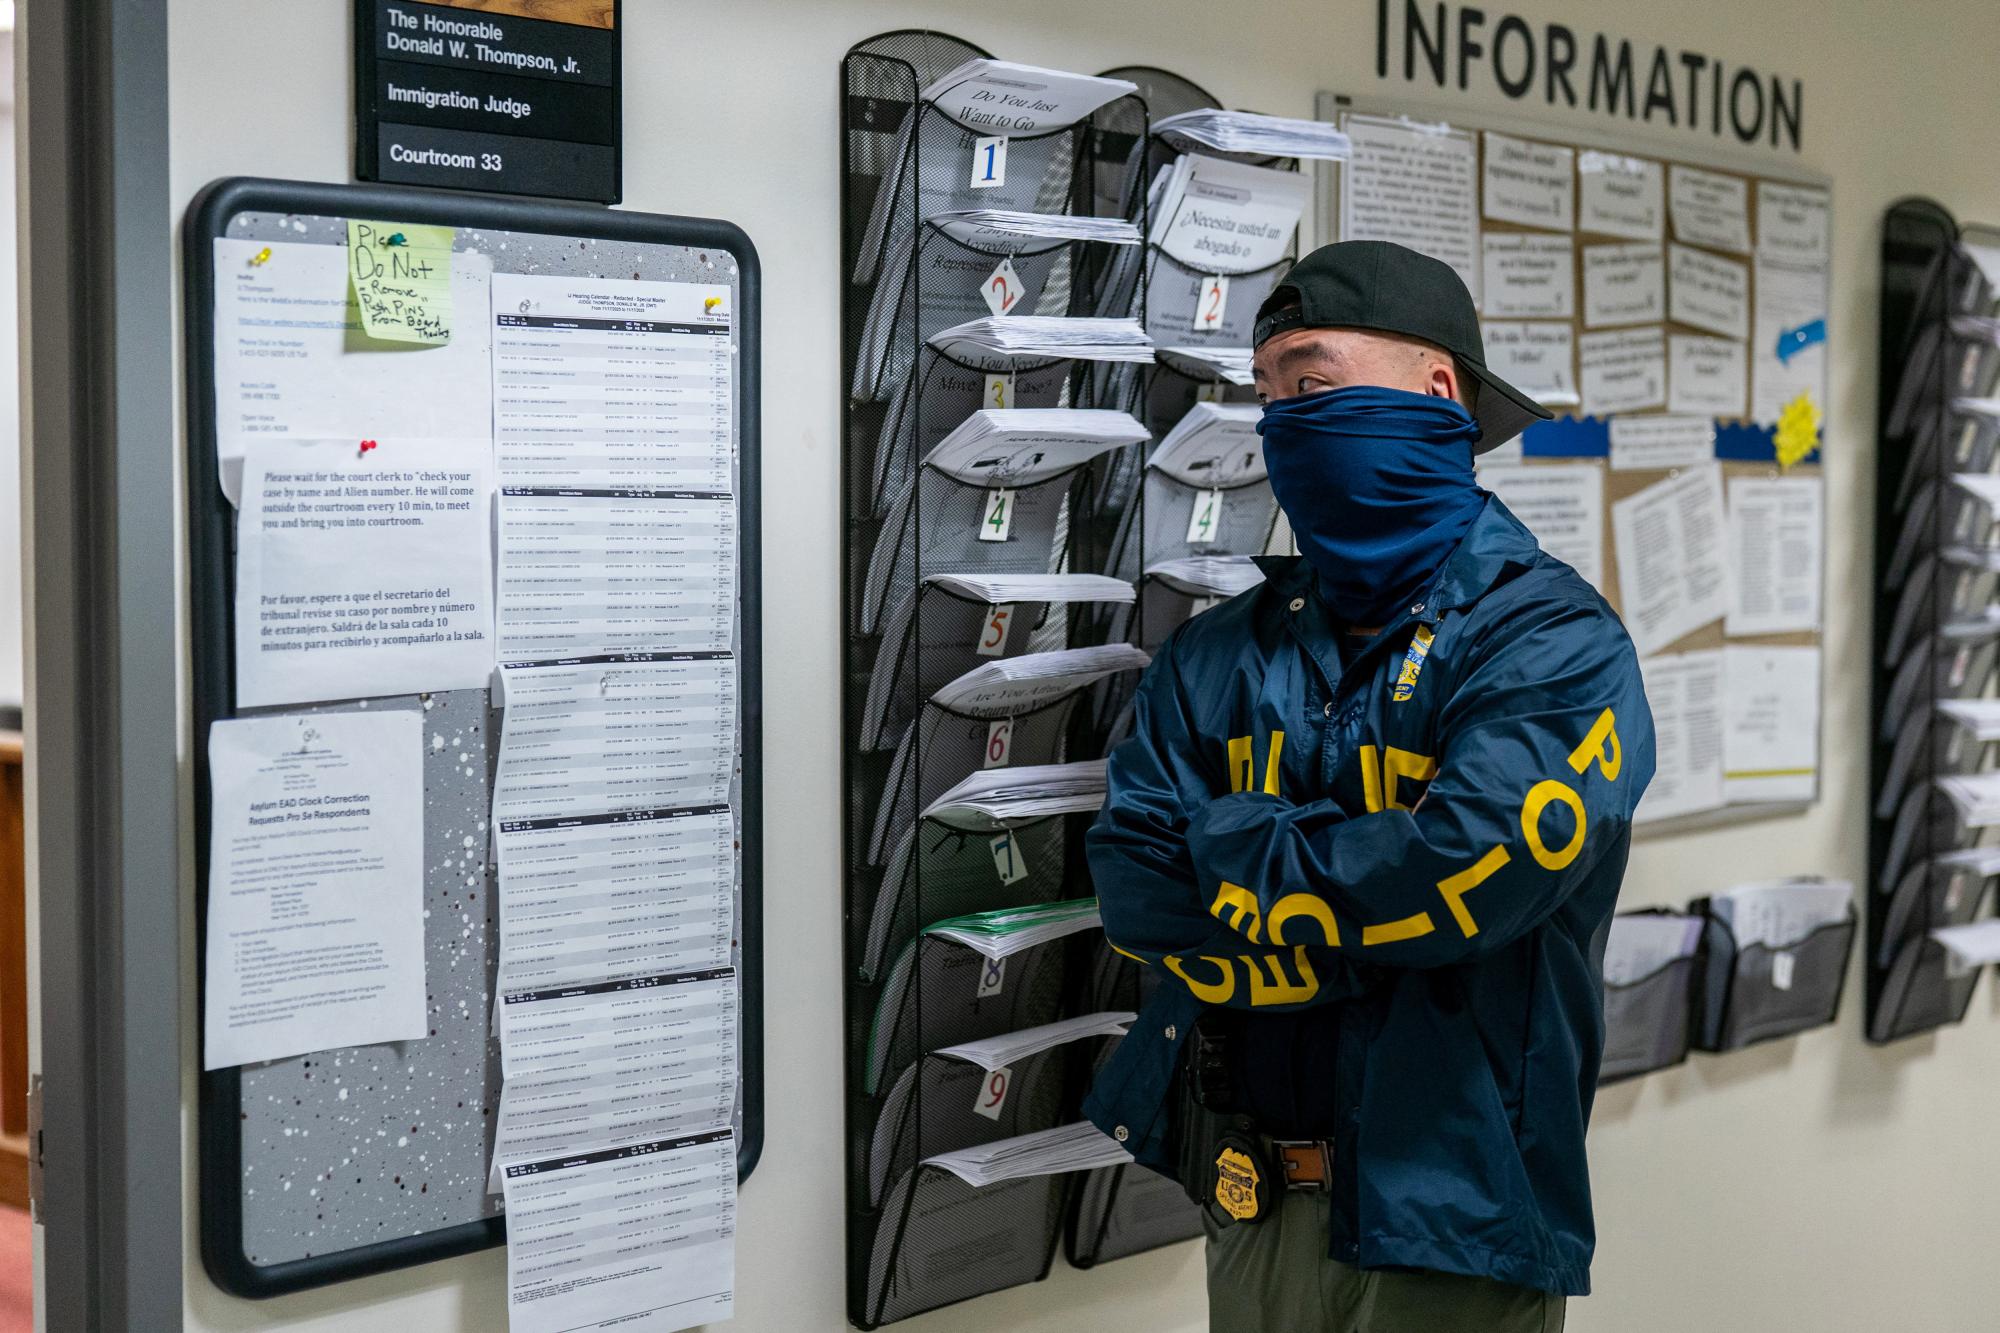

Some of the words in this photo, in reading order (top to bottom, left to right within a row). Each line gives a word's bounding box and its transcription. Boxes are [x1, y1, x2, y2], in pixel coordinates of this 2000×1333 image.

[388, 9, 418, 30] The
[424, 14, 503, 40] Honorable
[388, 32, 443, 56] Donald
[450, 40, 469, 59] W.
[475, 44, 557, 73] Thompson,
[563, 57, 581, 73] Jr.
[1376, 0, 1802, 152] INFORMATION
[388, 83, 478, 110] Immigration
[484, 96, 531, 118] Judge
[973, 90, 996, 101] Do
[1000, 94, 1027, 107] You
[1027, 100, 1058, 113] Just
[958, 106, 995, 124] Want
[997, 112, 1010, 126] to
[1014, 117, 1035, 131] Go
[390, 144, 475, 169] Courtroom
[481, 154, 502, 171] 33
[981, 144, 996, 181] 1
[356, 245, 383, 280] Do
[393, 252, 433, 279] Not
[991, 276, 1015, 311] 2
[1204, 287, 1220, 320] 2
[263, 489, 281, 498] case
[284, 488, 295, 499] by
[297, 489, 321, 497] name
[323, 487, 341, 496] and
[344, 487, 368, 496] Alien
[371, 487, 413, 496] number.
[415, 487, 428, 495] He
[430, 486, 447, 495] will
[264, 472, 291, 482] Please
[294, 473, 314, 482] wait
[315, 472, 327, 482] for
[330, 473, 345, 481] the
[348, 473, 373, 481] court
[376, 472, 400, 481] clerk
[403, 473, 413, 481] to
[449, 473, 471, 483] your
[262, 504, 295, 513] outside
[297, 503, 311, 512] the
[314, 503, 365, 512] courtroom
[367, 504, 395, 513] every
[399, 502, 409, 511] 10
[447, 502, 470, 510] meet
[988, 498, 1006, 533] 4
[1198, 502, 1211, 537] 4
[262, 520, 279, 530] you
[281, 519, 298, 528] and
[300, 518, 325, 529] bring
[327, 519, 344, 529] you
[346, 517, 365, 526] into
[368, 517, 424, 526] courtroom.
[261, 596, 277, 605] Por
[310, 595, 342, 604] espere
[353, 593, 370, 603] que
[373, 591, 382, 600] el
[384, 590, 433, 600] secretario
[436, 588, 450, 598] del
[261, 610, 300, 621] tribunal
[303, 609, 332, 619] revise
[372, 607, 388, 618] por
[391, 605, 430, 615] nombre
[261, 627, 272, 636] de
[365, 621, 376, 631] de
[379, 621, 388, 630] la
[390, 619, 409, 630] sala
[412, 618, 434, 628] cada
[436, 618, 447, 627] 10
[261, 641, 302, 651] minutos
[304, 641, 327, 651] para
[329, 636, 371, 648] recibirlo
[374, 638, 379, 647] y
[454, 631, 462, 641] la
[985, 612, 1008, 648] 5
[988, 725, 1009, 762] 6
[280, 799, 296, 807] EAD
[299, 797, 322, 806] Clock
[324, 794, 370, 804] Correction
[287, 813, 300, 822] Pro
[302, 812, 312, 820] Se
[314, 808, 370, 820] Respondents
[996, 832, 1013, 879] 7
[985, 958, 1001, 988] 8
[984, 1073, 1005, 1108] 9
